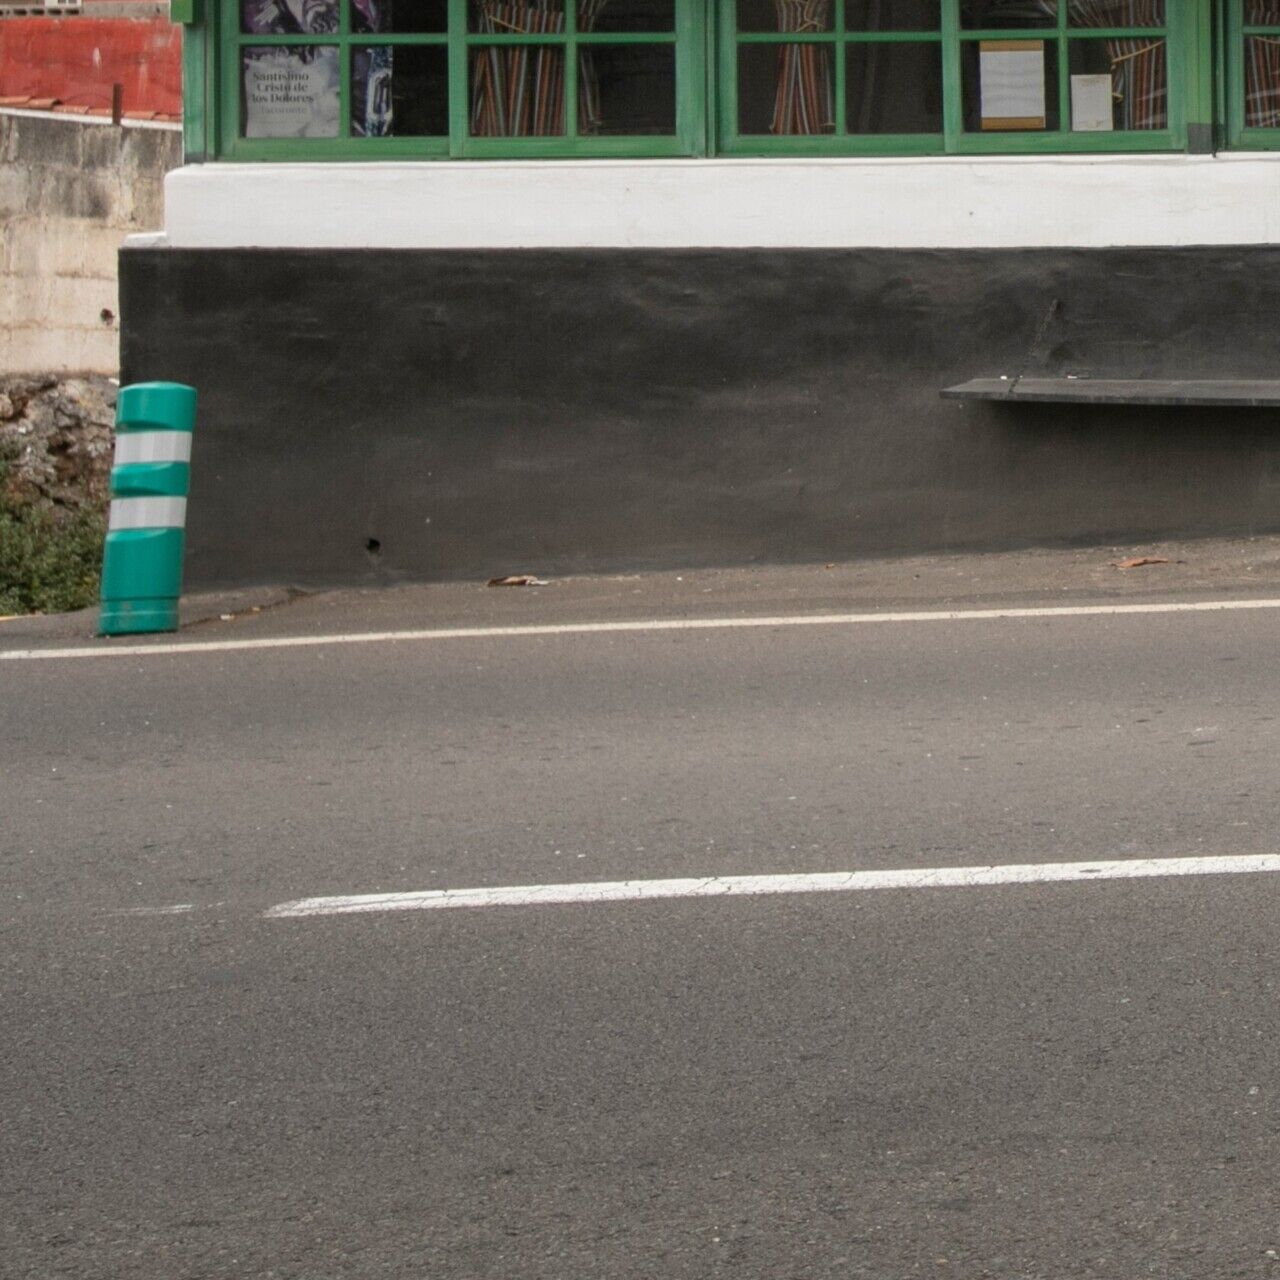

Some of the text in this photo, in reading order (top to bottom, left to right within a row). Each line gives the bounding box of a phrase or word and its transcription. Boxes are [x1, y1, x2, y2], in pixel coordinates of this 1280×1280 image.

[256, 82, 308, 91] Cristo de
[252, 93, 314, 103] los Dolores
